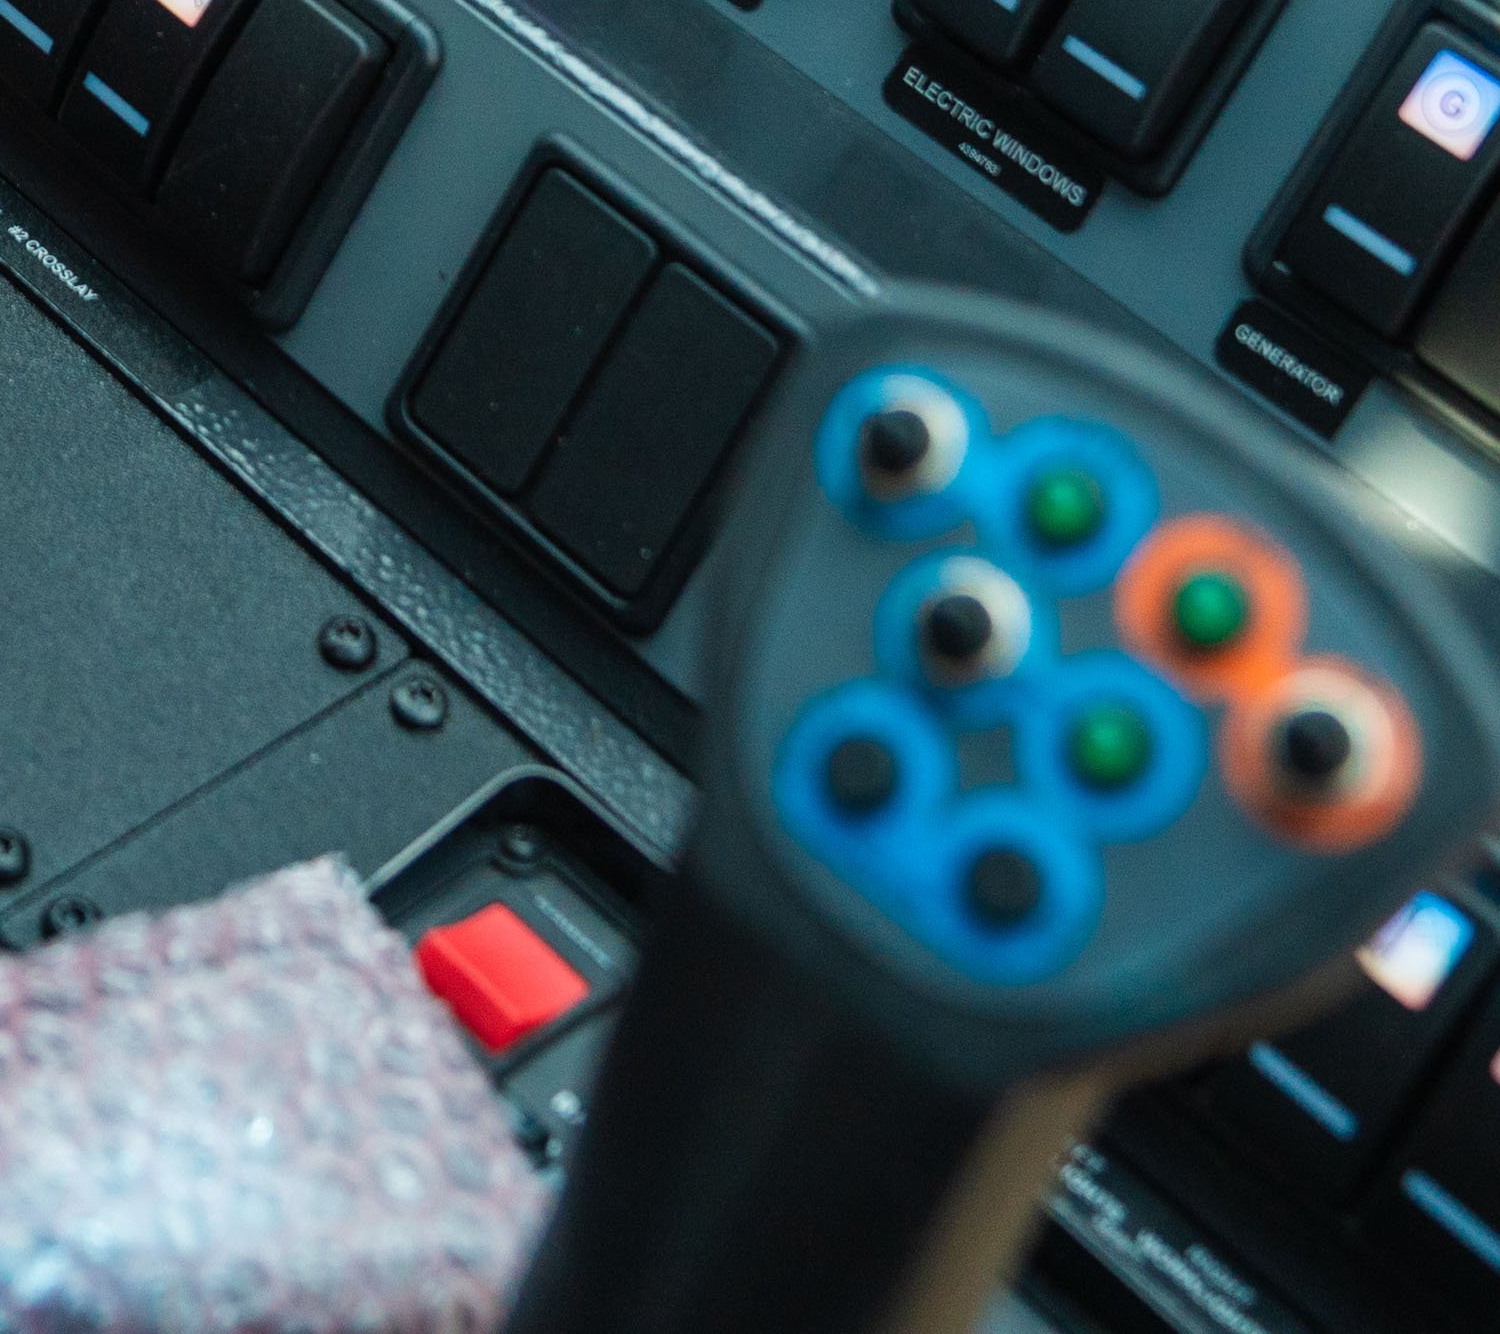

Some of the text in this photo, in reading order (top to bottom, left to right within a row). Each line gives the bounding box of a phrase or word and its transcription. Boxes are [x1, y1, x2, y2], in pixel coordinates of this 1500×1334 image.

[902, 65, 1089, 208] ELECTRIC WINDOWS
[7, 224, 31, 245] #2
[24, 238, 100, 303] CROSSLAY
[1233, 322, 1347, 408] GENERATOR
